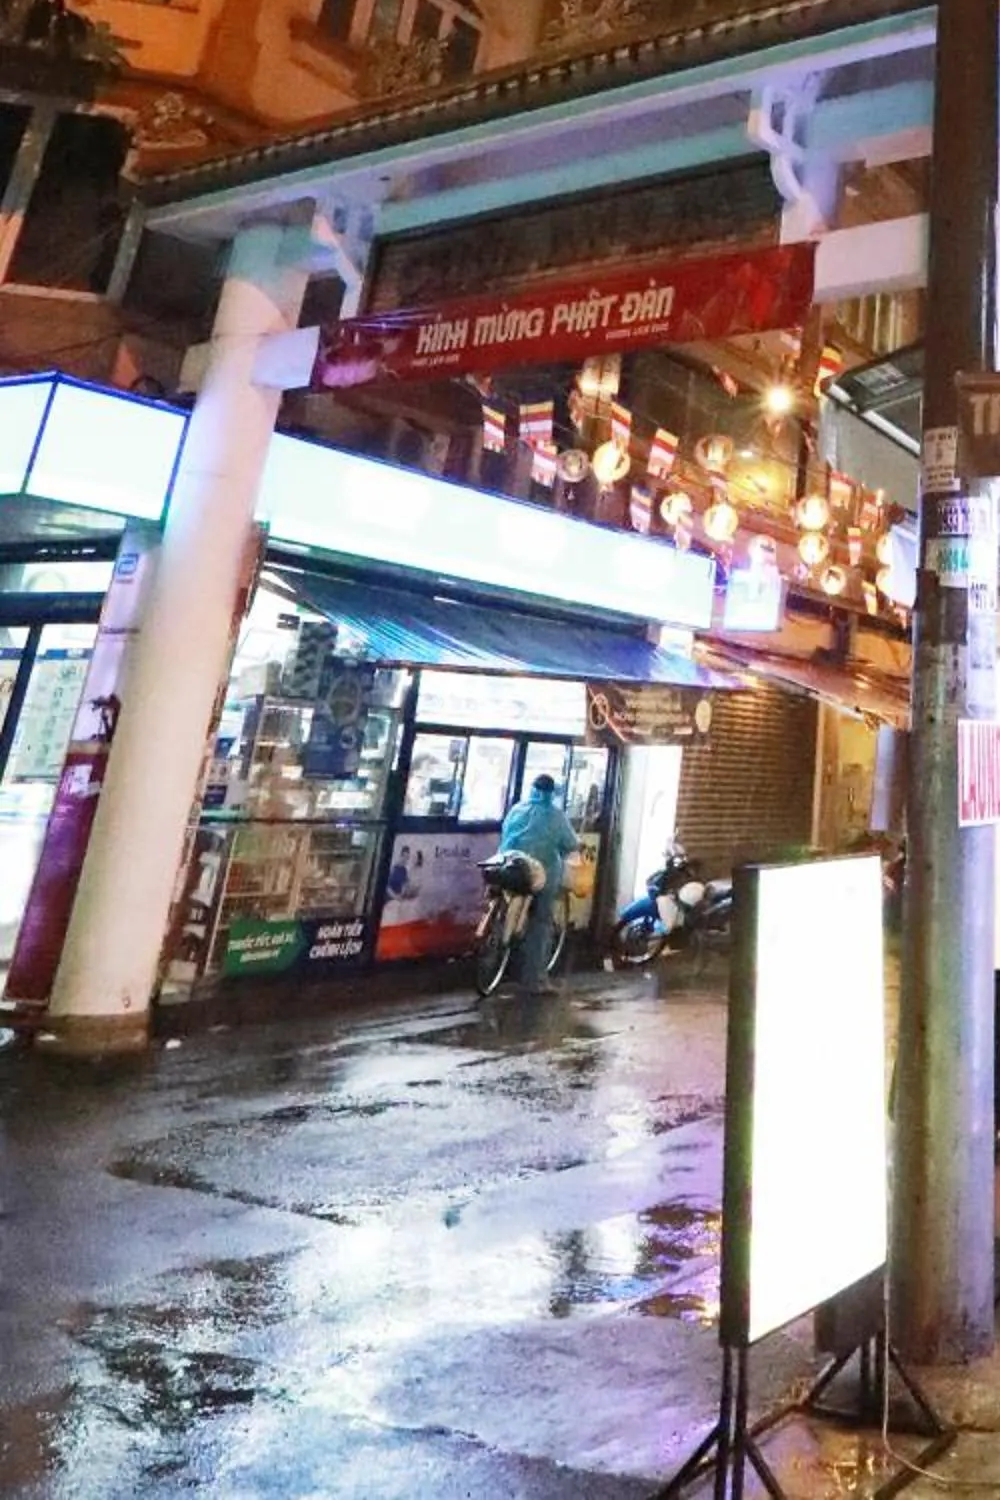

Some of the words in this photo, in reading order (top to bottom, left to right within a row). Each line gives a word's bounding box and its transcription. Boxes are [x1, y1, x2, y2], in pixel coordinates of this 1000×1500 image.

[415, 313, 469, 354] KÍNH
[473, 303, 544, 347] MỪNG
[550, 287, 618, 338] PHẬT
[619, 279, 675, 325] ĐẢN
